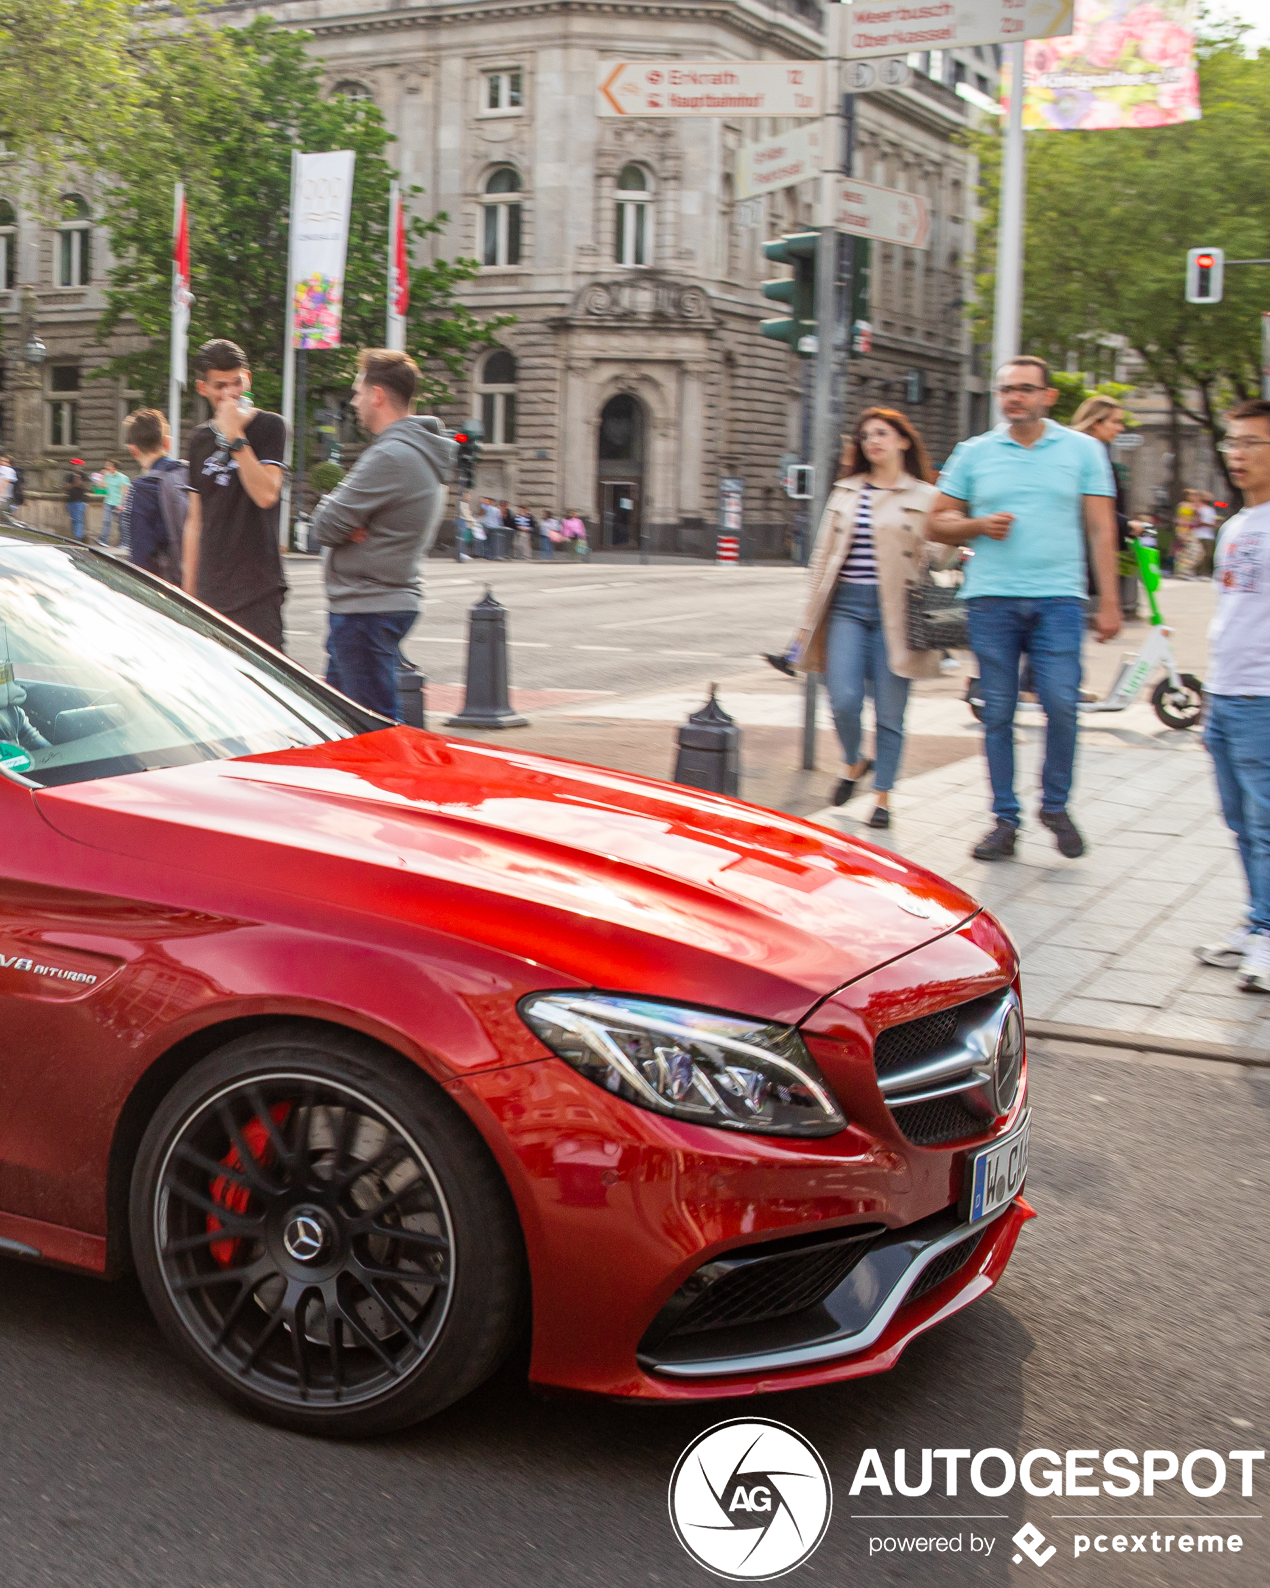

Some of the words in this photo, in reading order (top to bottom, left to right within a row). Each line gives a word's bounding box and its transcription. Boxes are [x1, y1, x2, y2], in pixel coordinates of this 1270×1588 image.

[851, 24, 956, 49] Oberkassel
[668, 69, 739, 85] Erkrath
[667, 93, 765, 111] Hauptbahnhof
[33, 965, 97, 985] BITURBO
